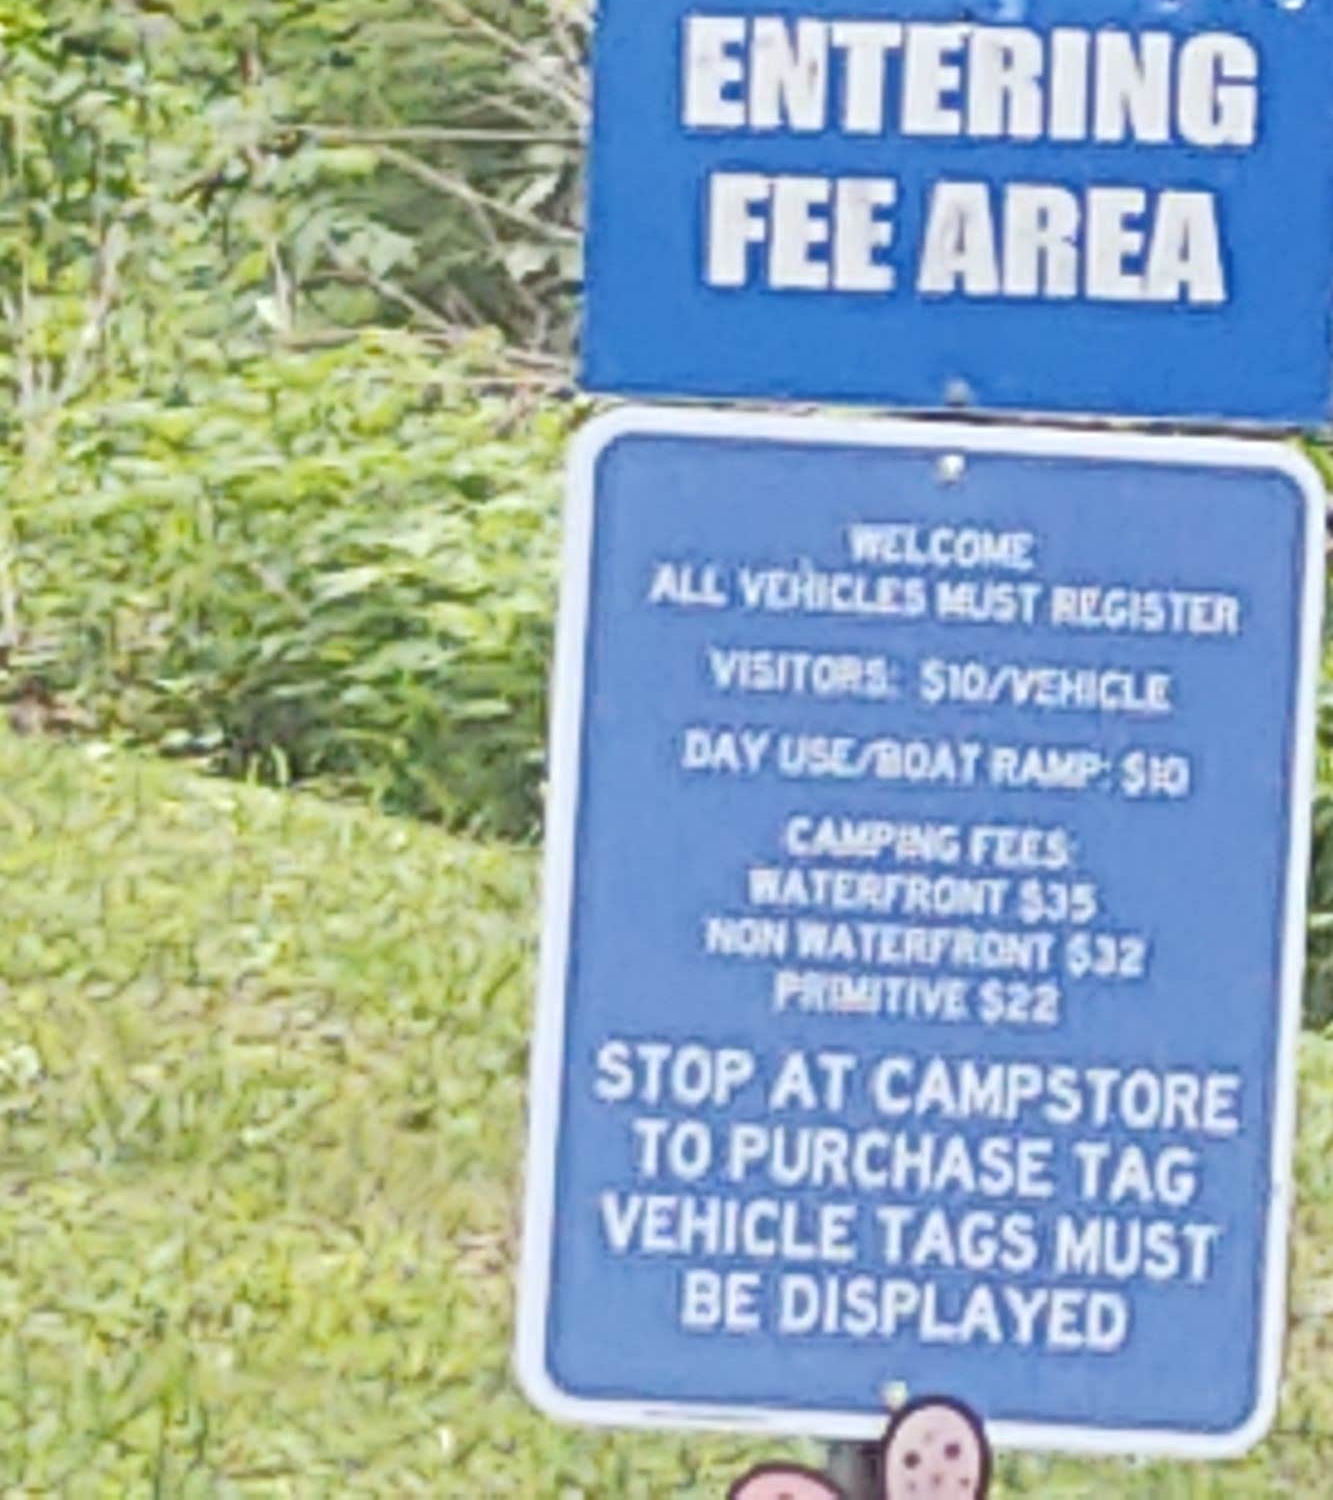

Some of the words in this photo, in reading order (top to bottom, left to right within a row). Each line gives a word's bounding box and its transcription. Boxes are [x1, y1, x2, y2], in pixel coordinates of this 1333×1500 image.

[680, 14, 1260, 146] ENTERING
[706, 172, 898, 293] FEE
[916, 179, 1228, 305] AREA
[846, 524, 1036, 571] WELCOME
[648, 564, 726, 607] ALL
[738, 568, 926, 619] VEHICLES
[934, 581, 1041, 624] MUST
[1048, 588, 1240, 636] REGISTER
[918, 660, 1173, 711] $10/VEHICLE
[681, 730, 770, 772] DAY
[778, 736, 982, 786] USE/BOAT
[991, 747, 1110, 790] RAMP:
[785, 815, 962, 863] CAMPING
[746, 868, 1008, 918] WATERFRONT
[1016, 880, 1098, 924] $35
[704, 918, 786, 956] NON
[794, 920, 1056, 974] WATERFRONT
[1064, 934, 1148, 980] $32
[771, 970, 969, 1020] PRIMITIVE
[593, 1040, 754, 1105] STOP
[767, 1051, 859, 1113] AT
[872, 1057, 1244, 1135] CAMPSTORE
[632, 1117, 712, 1180] TO
[728, 1123, 1056, 1200] PURCHASE
[1074, 1143, 1196, 1206] TAG
[600, 1192, 856, 1263] VEHICLE
[876, 1206, 1039, 1272] TAGS
[1055, 1216, 1220, 1280] MUST
[679, 1268, 762, 1331] BE
[777, 1273, 1131, 1349] DISPLAYED
